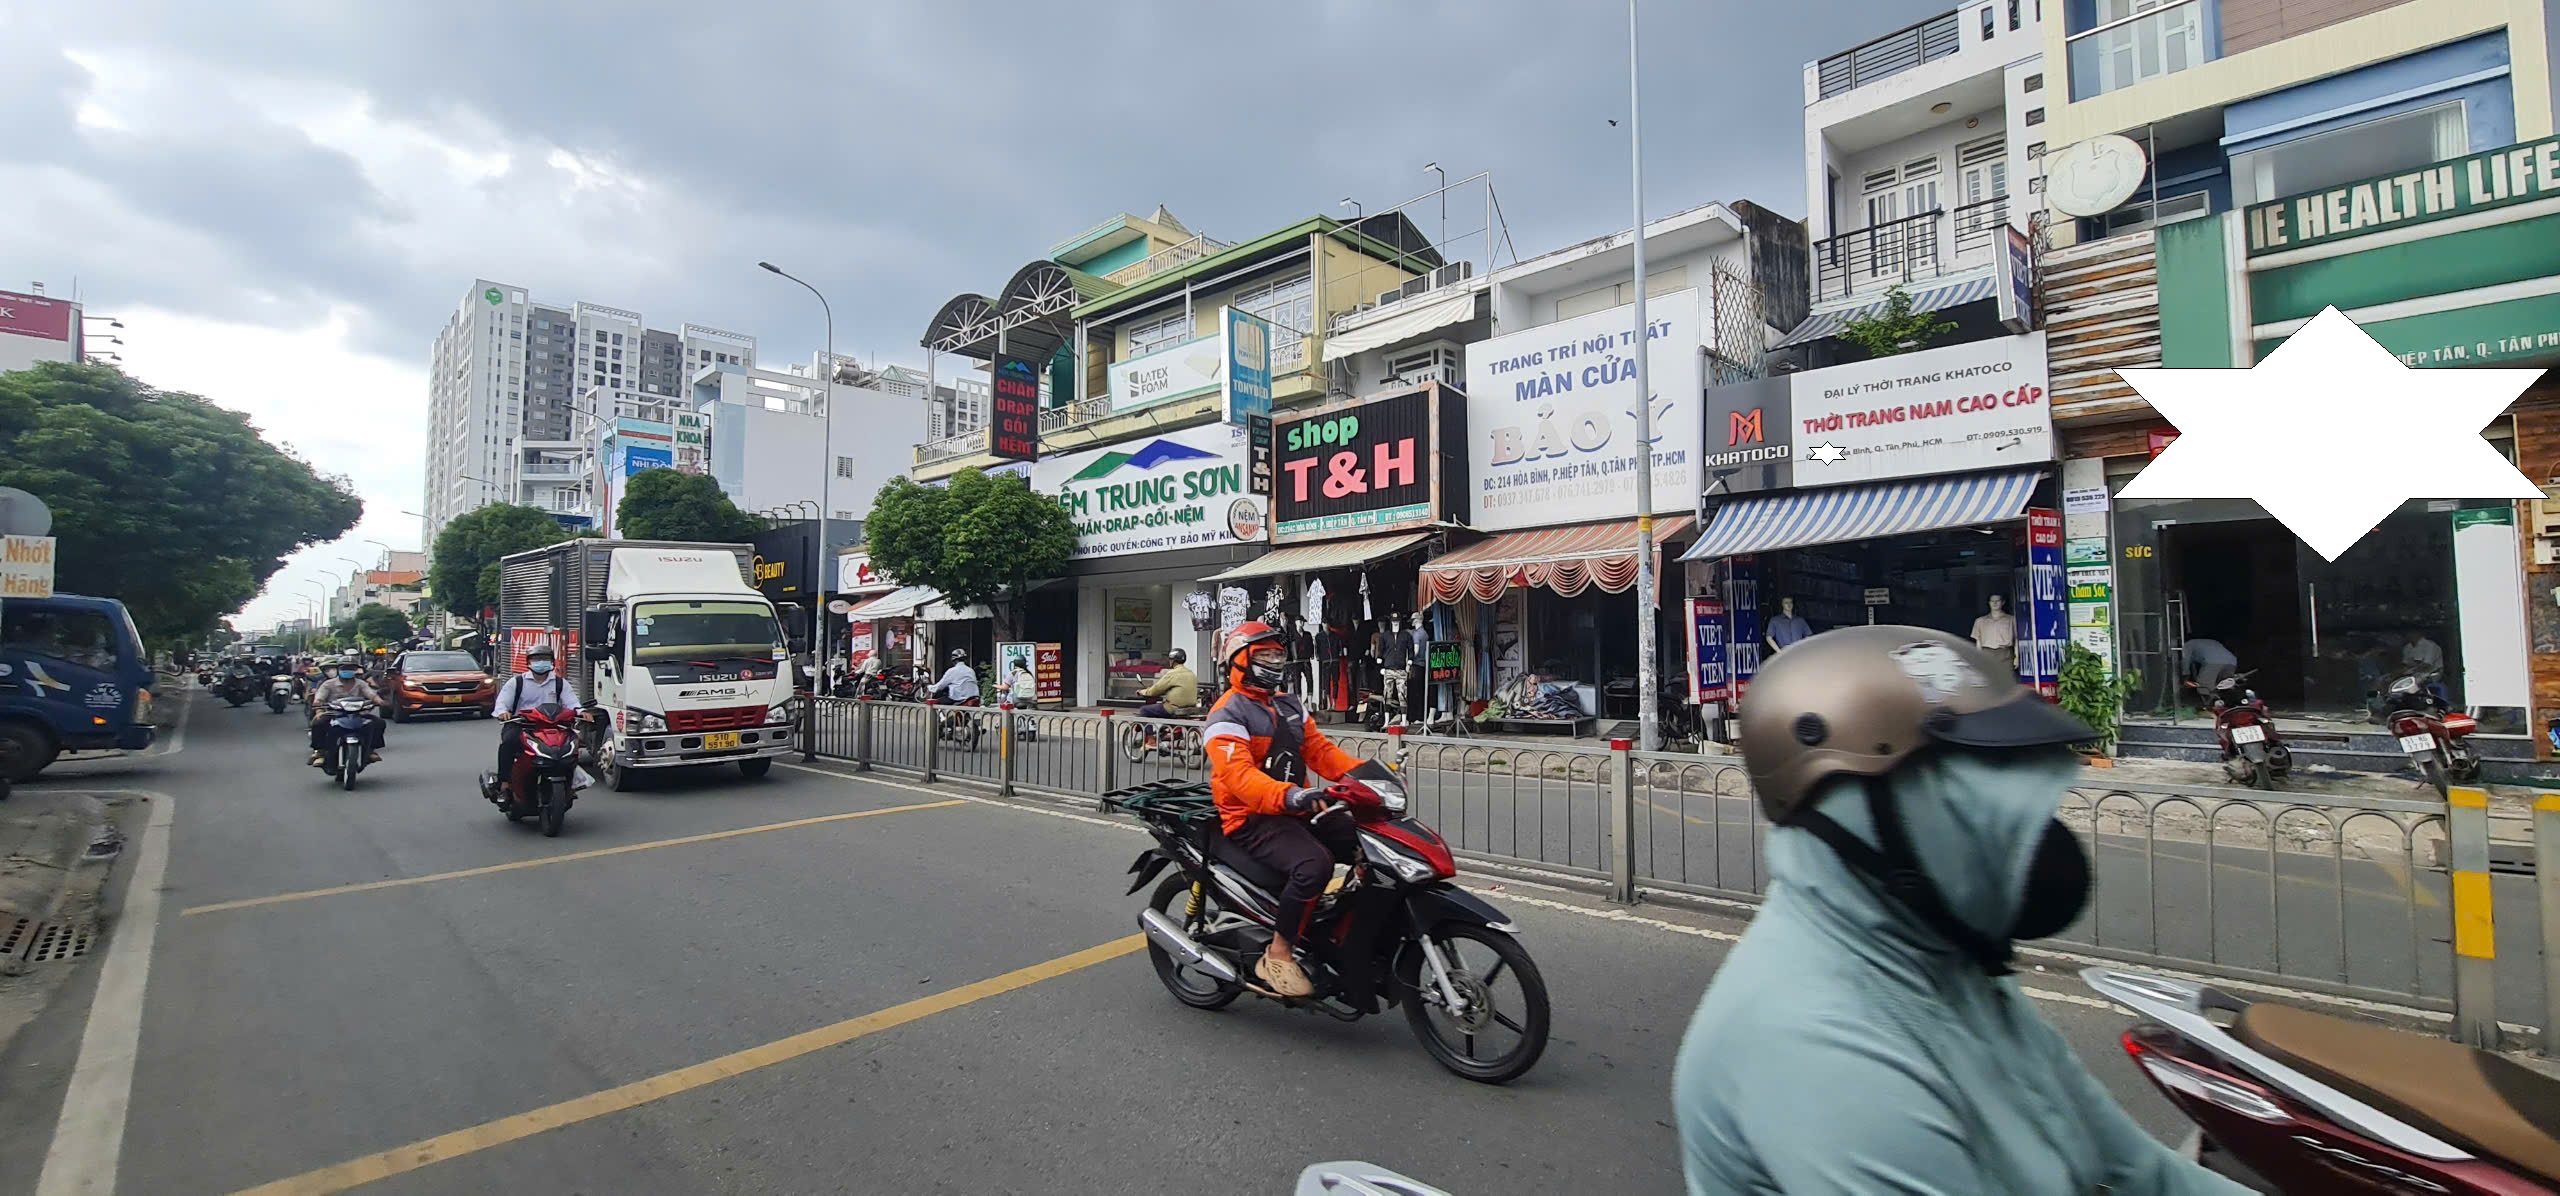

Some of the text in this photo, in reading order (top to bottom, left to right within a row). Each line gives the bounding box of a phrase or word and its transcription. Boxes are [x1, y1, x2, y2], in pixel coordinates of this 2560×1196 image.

[2297, 165, 2455, 240] HEALTH
[2467, 141, 2560, 205] LIFE
[1489, 319, 1671, 375] TRANG TRÍ NỘI TẤT
[2476, 342, 2492, 358] Q.
[2498, 335, 2532, 353] TÂN
[1140, 367, 1168, 384] LATEX
[1142, 379, 1168, 395] FOAM
[1516, 354, 1636, 401] MÀN CỬA
[1824, 362, 2012, 399] ĐẠI LÝ THỜI TRANG KHATOCO
[997, 398, 1034, 416] DRAP
[1803, 383, 2042, 434] THỜI TRANG NAM CAO CẤP
[1288, 415, 1359, 451] shop
[1491, 403, 1612, 467] BẢO
[1923, 438, 1942, 446] HCM
[1705, 445, 1788, 467] KHATOCO
[1497, 475, 1511, 488] 214
[1513, 470, 1528, 485] HÒA
[1530, 467, 1550, 484] BÌNH,
[1553, 462, 1578, 481] P.HIỆP
[1581, 460, 1599, 478] TÂN,
[1601, 455, 1626, 474] Q.TÂN
[1652, 450, 1686, 467] TP.HCM
[1096, 475, 1177, 513] TRUNG
[1183, 464, 1241, 500] SƠN
[1166, 536, 1177, 546] TY
[1181, 531, 1198, 544] BẢO
[2125, 543, 2152, 558] SỨC
[765, 562, 785, 579] BEAUTY
[1699, 618, 1723, 651] VIỆT
[1007, 646, 1031, 656] SALE
[700, 674, 737, 682] ISUZU
[1701, 652, 1725, 685] TIẾN
[697, 688, 735, 696] AMG
